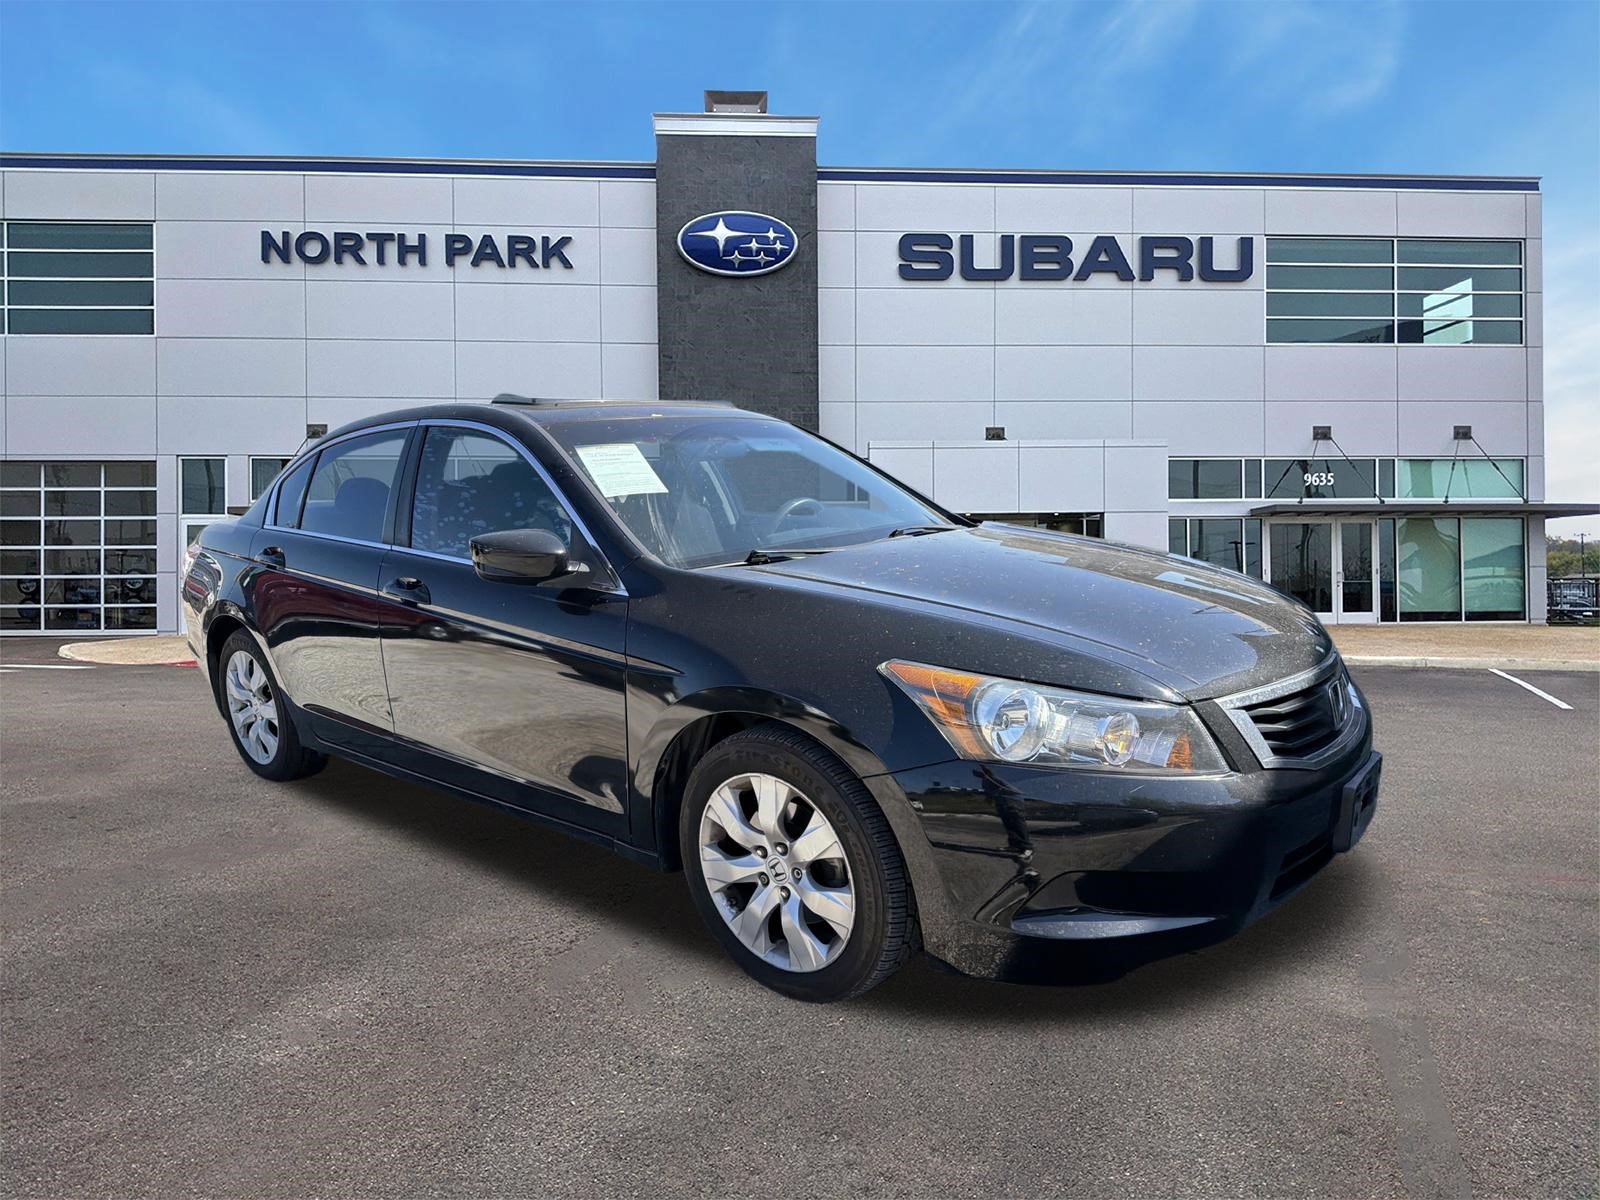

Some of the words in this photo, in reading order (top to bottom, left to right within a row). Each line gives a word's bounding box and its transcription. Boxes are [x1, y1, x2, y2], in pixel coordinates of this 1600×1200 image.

[260, 230, 427, 267] NORTH
[444, 233, 574, 269] PARK
[898, 233, 1254, 282] SUBARU
[1303, 472, 1335, 486] 9635
